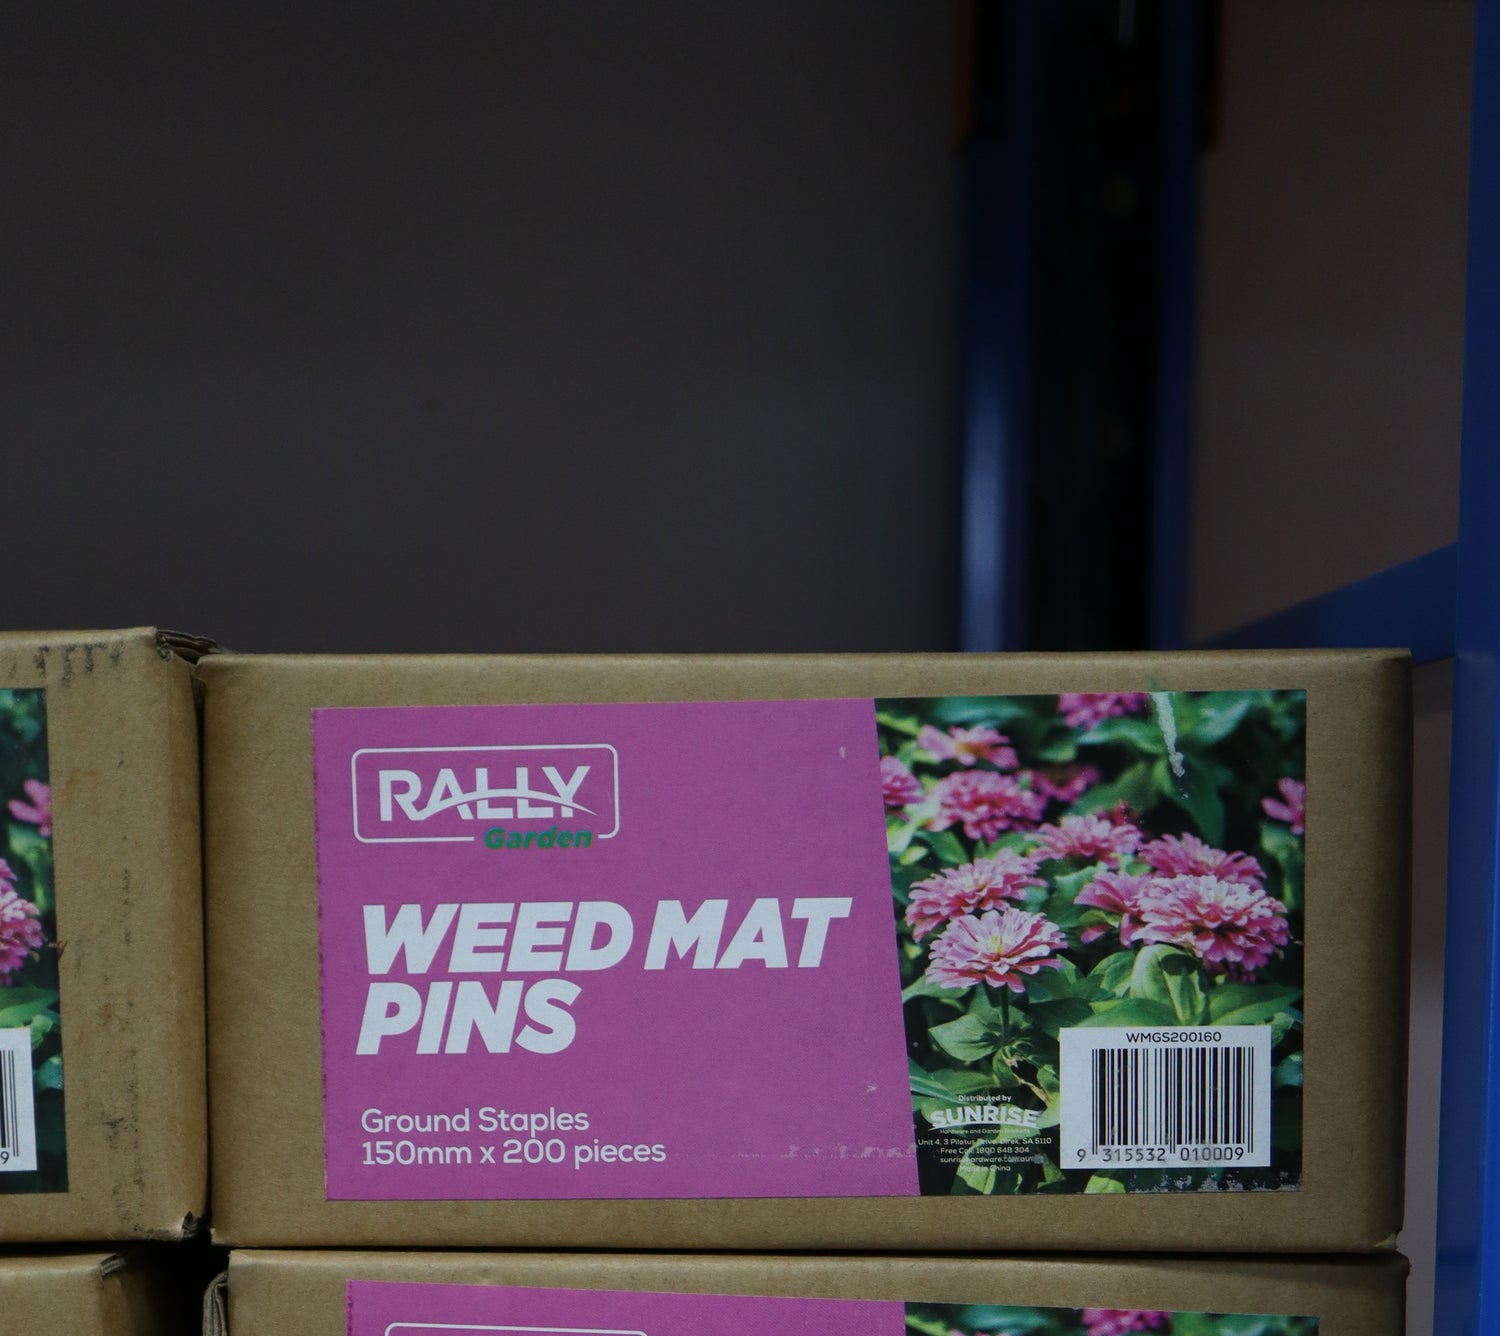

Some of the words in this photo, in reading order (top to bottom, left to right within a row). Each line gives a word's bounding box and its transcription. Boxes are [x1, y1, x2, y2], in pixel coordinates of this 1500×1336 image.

[379, 766, 598, 822] RALLY
[484, 826, 593, 850] Garden
[363, 900, 634, 975] WEED
[643, 897, 853, 970] MAT
[356, 978, 582, 1055] PINS
[1126, 1031, 1222, 1043] WMGS200160
[1002, 1095, 1012, 1103] by
[362, 1107, 470, 1133] Ground
[478, 1106, 590, 1137] Staples
[929, 1105, 1041, 1127] SUNRISE
[362, 1139, 473, 1166] 150mm
[480, 1145, 495, 1163] x
[503, 1138, 566, 1164] 200
[574, 1139, 666, 1169] pieces
[1014, 1146, 1030, 1154] 304
[1077, 1149, 1086, 1162] 9
[1103, 1148, 1166, 1162] 315532
[1180, 1147, 1244, 1161] 010009
